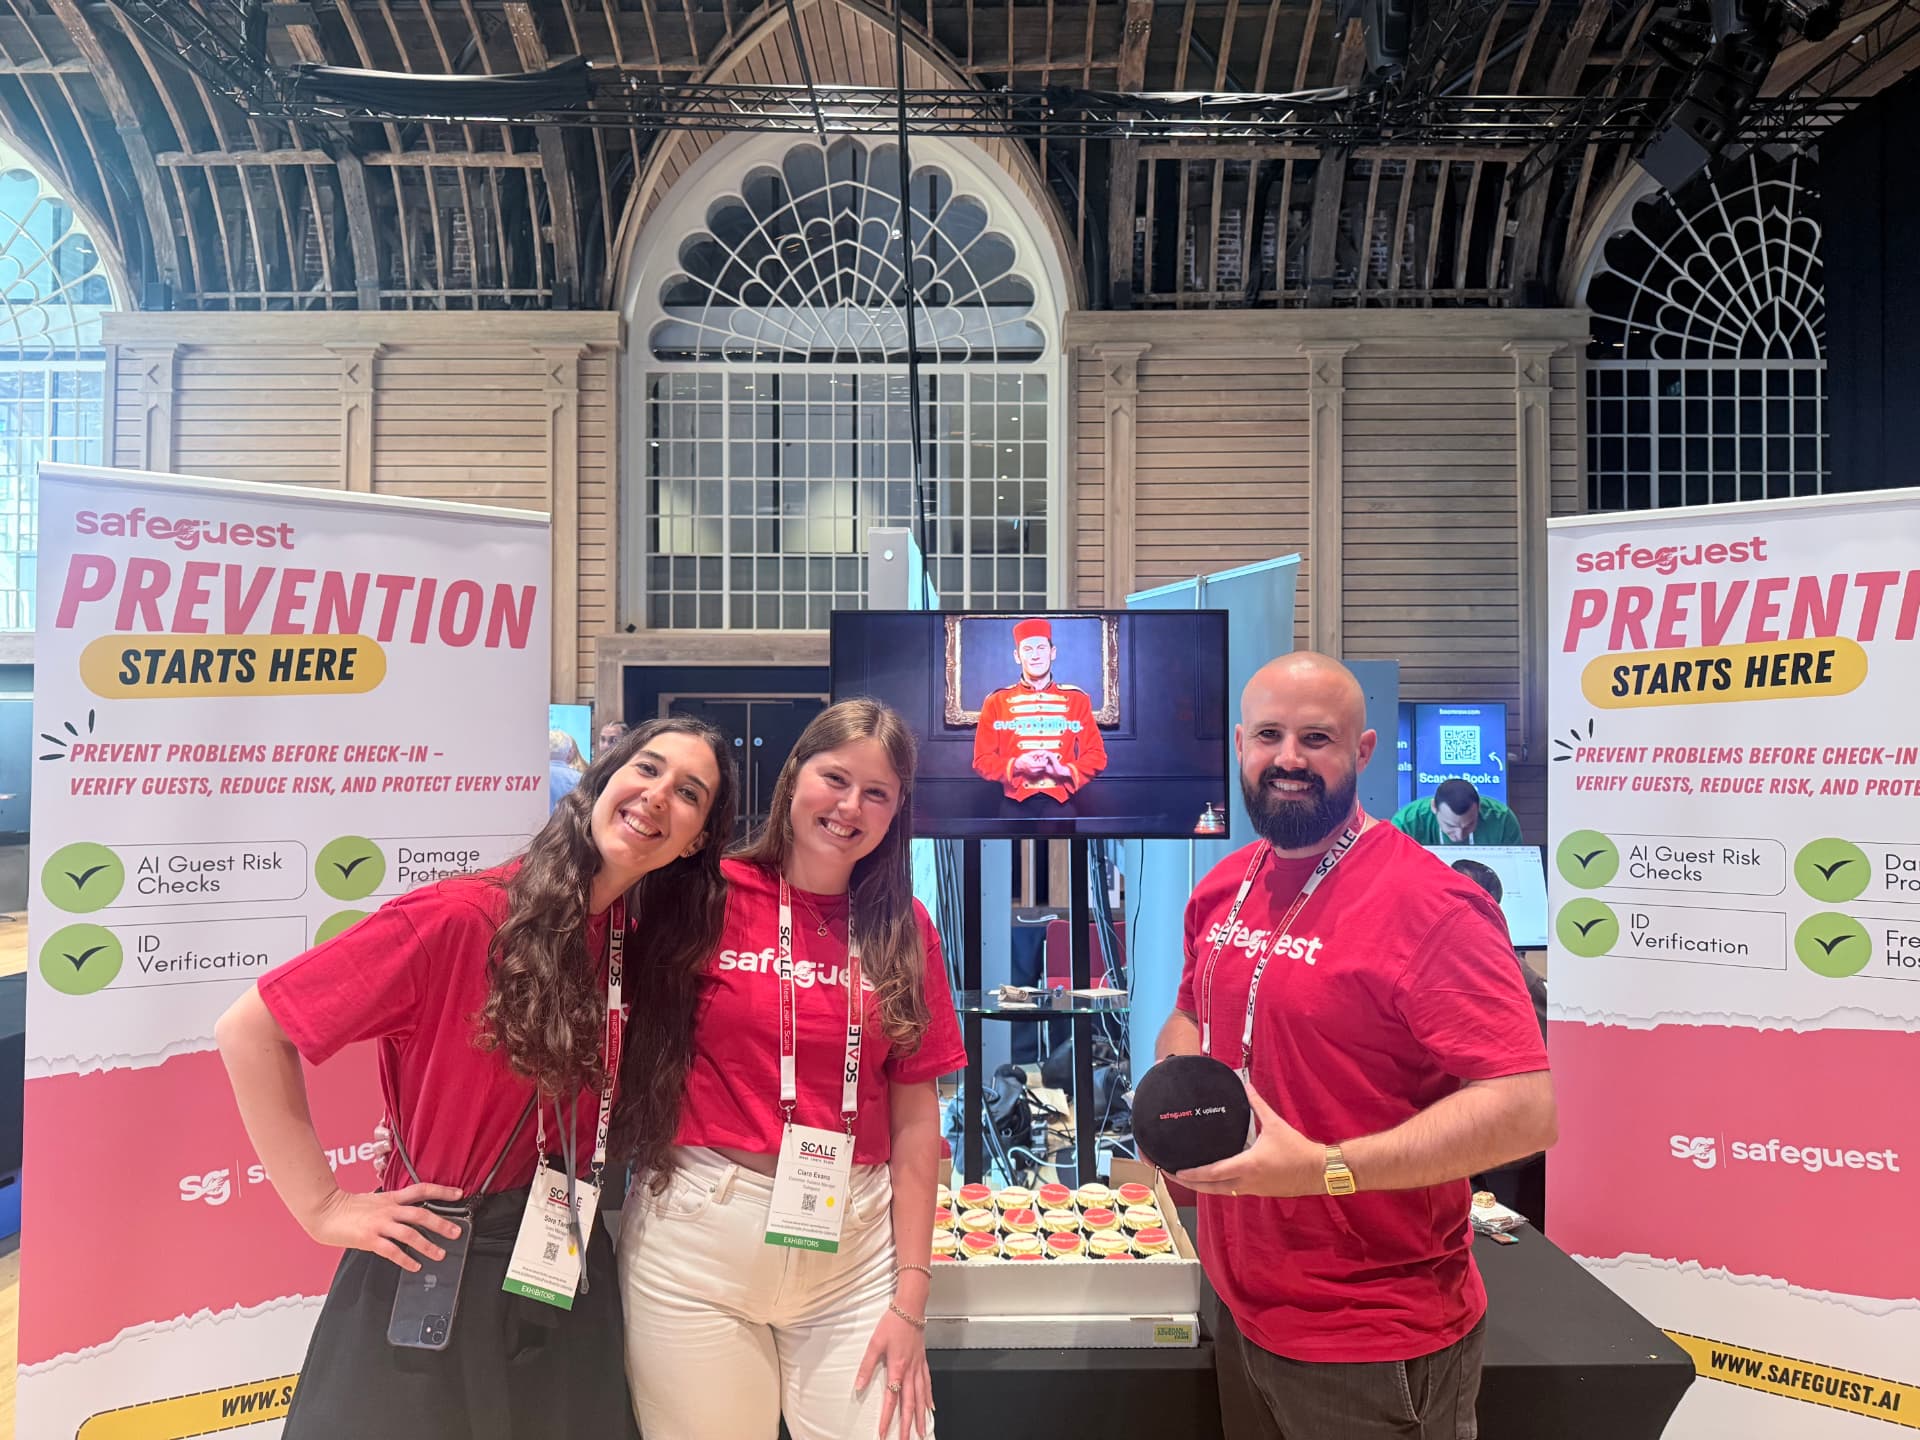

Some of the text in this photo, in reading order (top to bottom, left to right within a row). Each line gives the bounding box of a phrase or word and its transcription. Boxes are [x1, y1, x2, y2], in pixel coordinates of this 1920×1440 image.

[76, 508, 295, 550] safeguest
[1576, 537, 1768, 575] safeguest
[55, 554, 536, 649] PREVENTION
[118, 647, 358, 685] STARTS HERE
[1611, 650, 1835, 696] STARTS HERE
[70, 743, 162, 762] PREVENT
[166, 744, 266, 762] PROBLEMS
[271, 745, 339, 762] BEFORE
[343, 745, 428, 762] CHECK-IN
[1575, 747, 1918, 765] PREVENT PROBLEMS BEFORE CHECK-IN
[70, 776, 541, 797] VERIFY GUESTS, REDUCE RISK, AND PROTECT EVERY STAY
[1576, 776, 1628, 791] VERIFY
[1632, 776, 1693, 795] GUESTS,
[1700, 777, 1764, 793] REDUCE
[1769, 778, 1814, 797] RISK,
[1820, 779, 1859, 795] AND
[137, 852, 283, 876] AI Guest Risk
[398, 848, 480, 867] Damage
[1316, 830, 1356, 876] SCALE
[1629, 845, 1761, 866] AI Guest Risk
[1885, 854, 1920, 871] Da
[1629, 863, 1702, 882] Checks
[1885, 873, 1920, 892] Pro
[137, 874, 221, 895] Checks
[1631, 913, 1649, 930] ID
[138, 935, 160, 953] ID
[780, 926, 791, 978] SCALE
[1206, 920, 1323, 966] sfegest
[1631, 931, 1749, 956] Verification
[137, 949, 269, 974] Verification
[610, 931, 623, 987] SCALE
[1886, 949, 1920, 968] Ho
[845, 1026, 861, 1083] SCALE
[800, 1141, 837, 1157] SCALE
[1669, 1135, 1717, 1169] sg
[1731, 1139, 1900, 1172] safeguest
[179, 1168, 231, 1206] sg
[549, 1187, 582, 1207] SCAE
[783, 1236, 819, 1248] EXHIBITORS
[520, 1285, 556, 1301] EXHIBITORS
[1710, 1350, 1901, 1412] WWW.SAFEGUEST.AI
